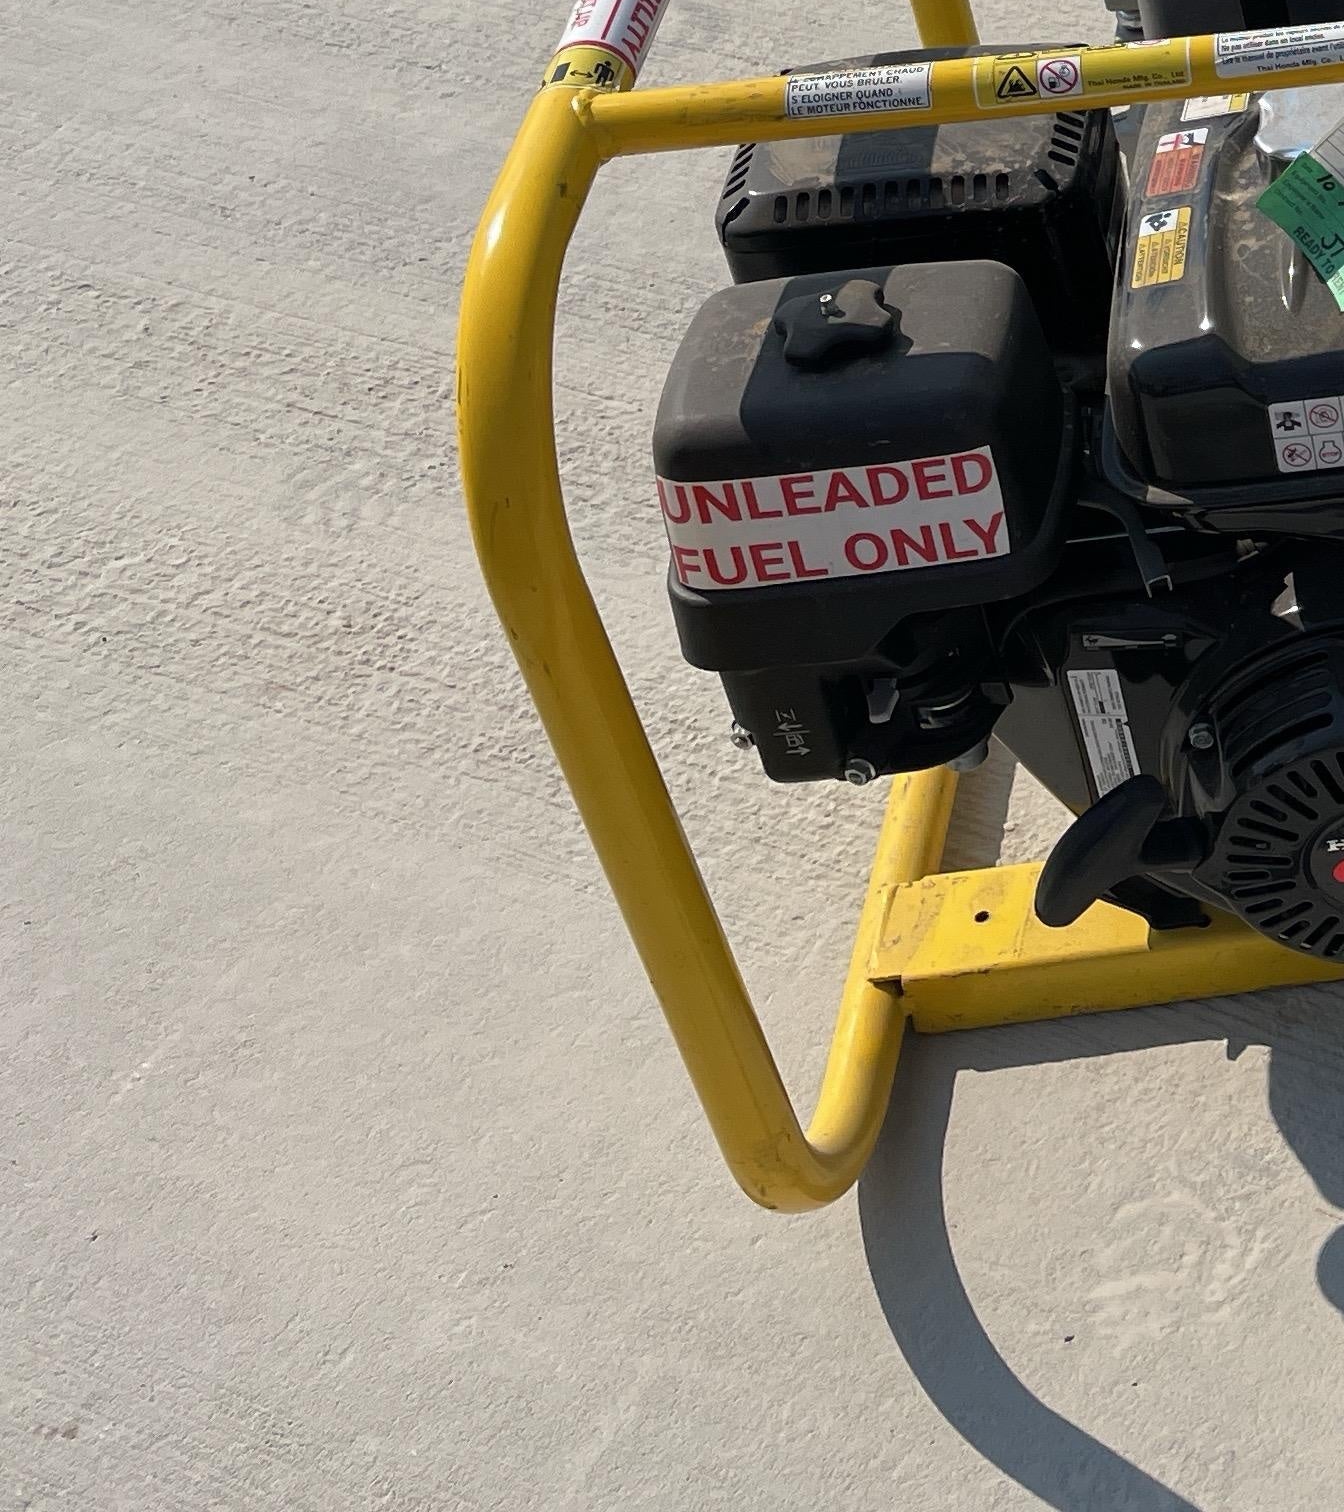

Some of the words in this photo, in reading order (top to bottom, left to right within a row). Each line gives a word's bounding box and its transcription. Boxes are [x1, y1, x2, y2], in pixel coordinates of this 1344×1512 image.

[1274, 60, 1300, 70] Honda
[790, 81, 819, 93] PEUT
[825, 78, 853, 90] VOUS
[855, 86, 893, 100] QUAND
[790, 106, 802, 115] LE
[806, 101, 851, 115] MOTEUR
[1173, 227, 1187, 265] CAUTION
[1294, 226, 1326, 259] READY
[1322, 258, 1335, 274] TO
[656, 452, 993, 525] UNLEADED
[672, 540, 830, 586] FUEL
[844, 511, 1004, 572] ONLY
